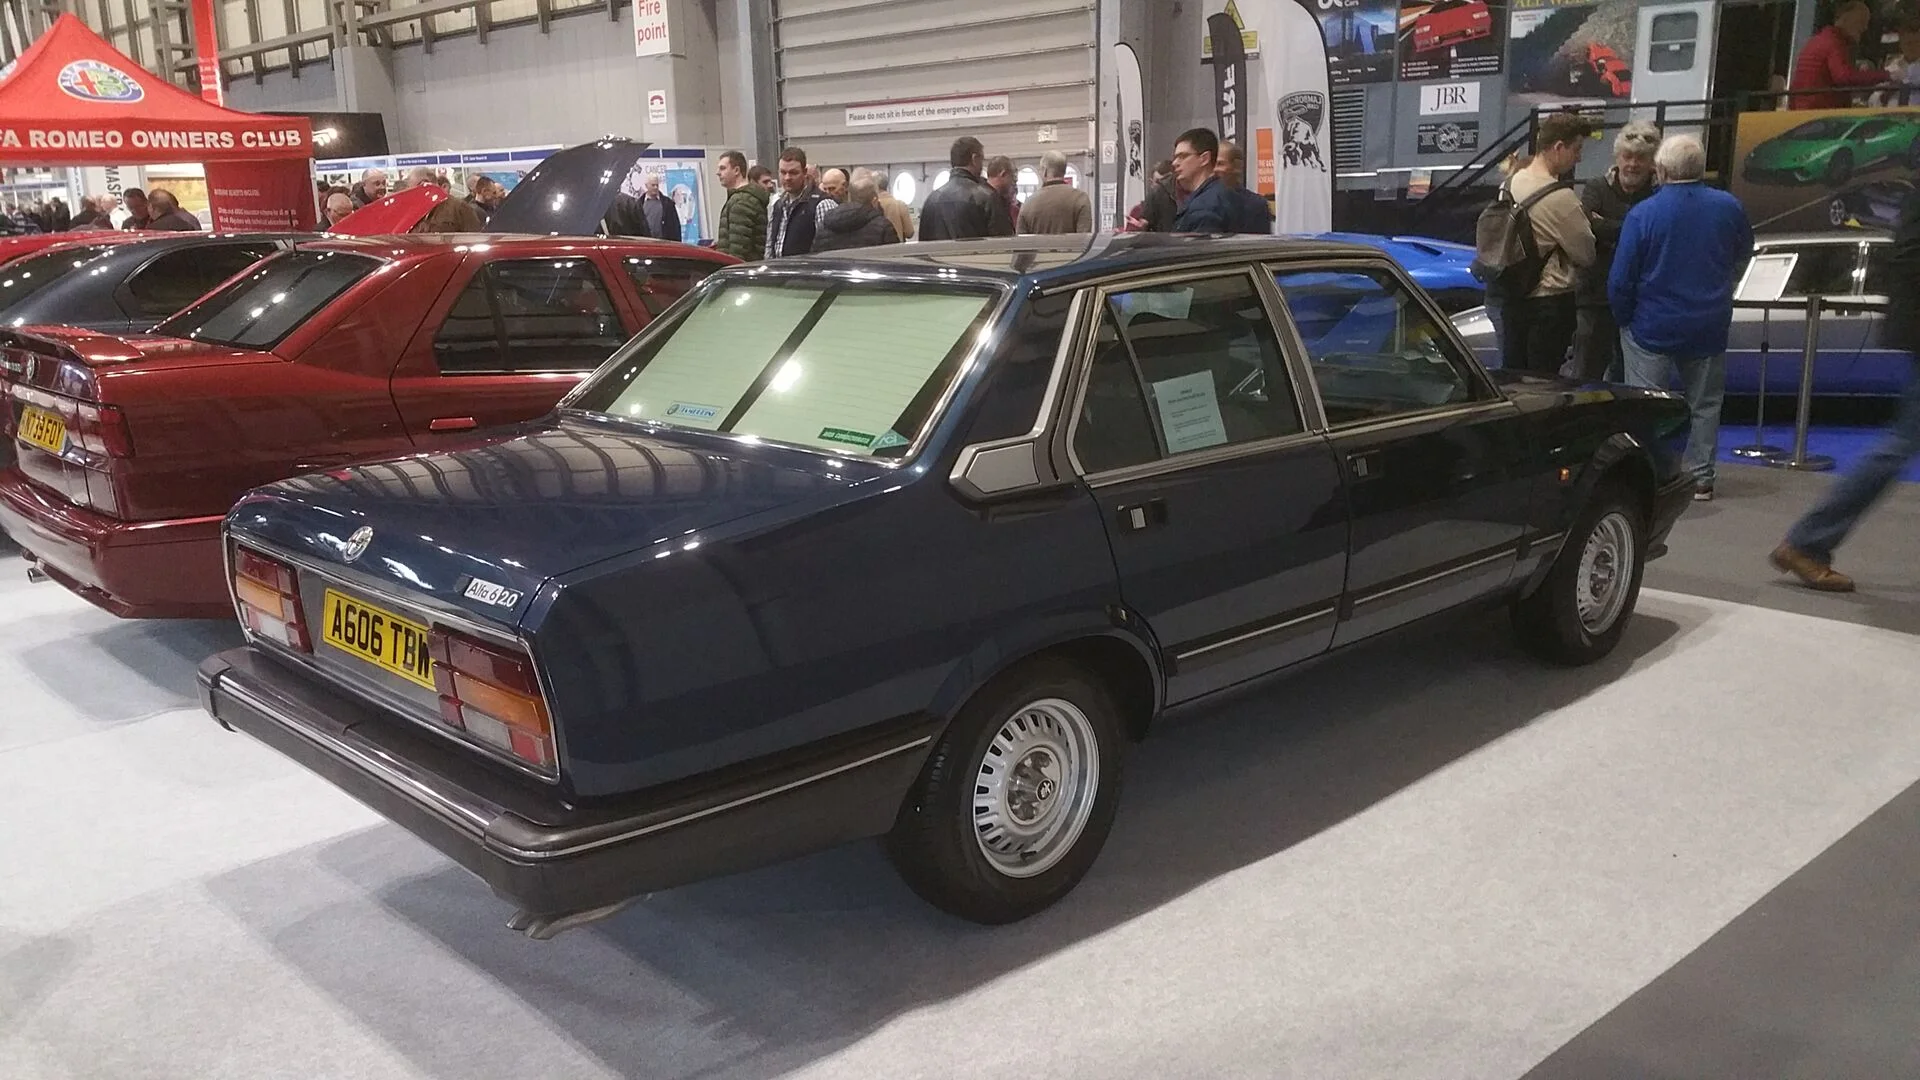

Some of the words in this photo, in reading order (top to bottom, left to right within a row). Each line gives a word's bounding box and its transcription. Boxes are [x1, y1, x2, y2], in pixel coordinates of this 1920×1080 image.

[638, 0, 661, 17] Fire
[637, 22, 667, 46] point
[848, 113, 866, 121] Please
[867, 112, 875, 120] do
[902, 109, 917, 118] front
[918, 107, 925, 116] of
[926, 106, 936, 115] the
[937, 105, 971, 116] emergency
[972, 103, 985, 112] exit
[986, 101, 1005, 111] doors
[1430, 86, 1467, 112] JBR
[0, 129, 22, 148] A
[29, 130, 123, 148] ROMEO
[131, 130, 235, 148] OWNERS
[241, 130, 301, 148] CLUB
[468, 581, 488, 597] Alfa
[489, 589, 498, 601] 6
[499, 591, 519, 608] 2.0
[331, 599, 384, 657] A606
[390, 621, 430, 679] TBW
